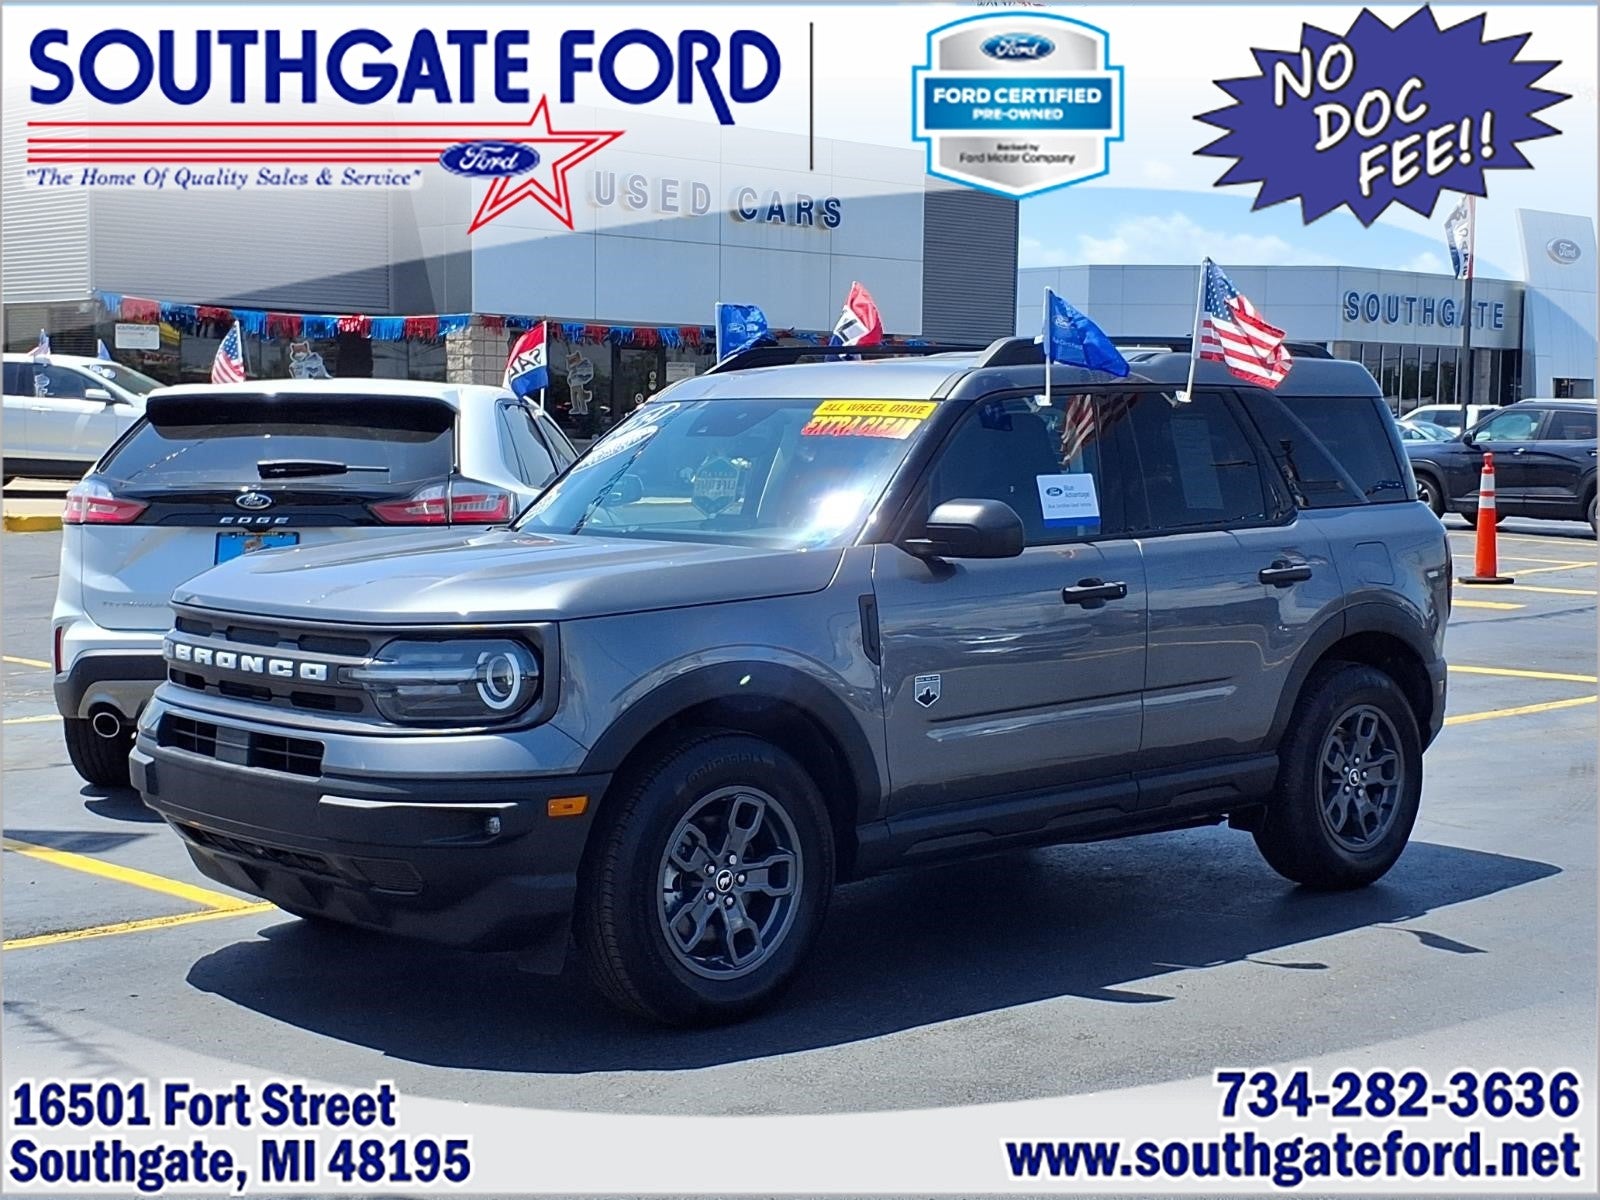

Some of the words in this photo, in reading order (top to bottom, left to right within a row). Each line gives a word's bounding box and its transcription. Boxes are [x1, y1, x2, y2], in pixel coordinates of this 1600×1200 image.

[593, 171, 712, 217] USED
[736, 187, 842, 229] CARS
[821, 403, 844, 412] ALL
[847, 403, 885, 413] WHEEL
[888, 404, 929, 415] DRIVE
[219, 516, 290, 524] EDGE
[174, 643, 328, 682] BRONCO
